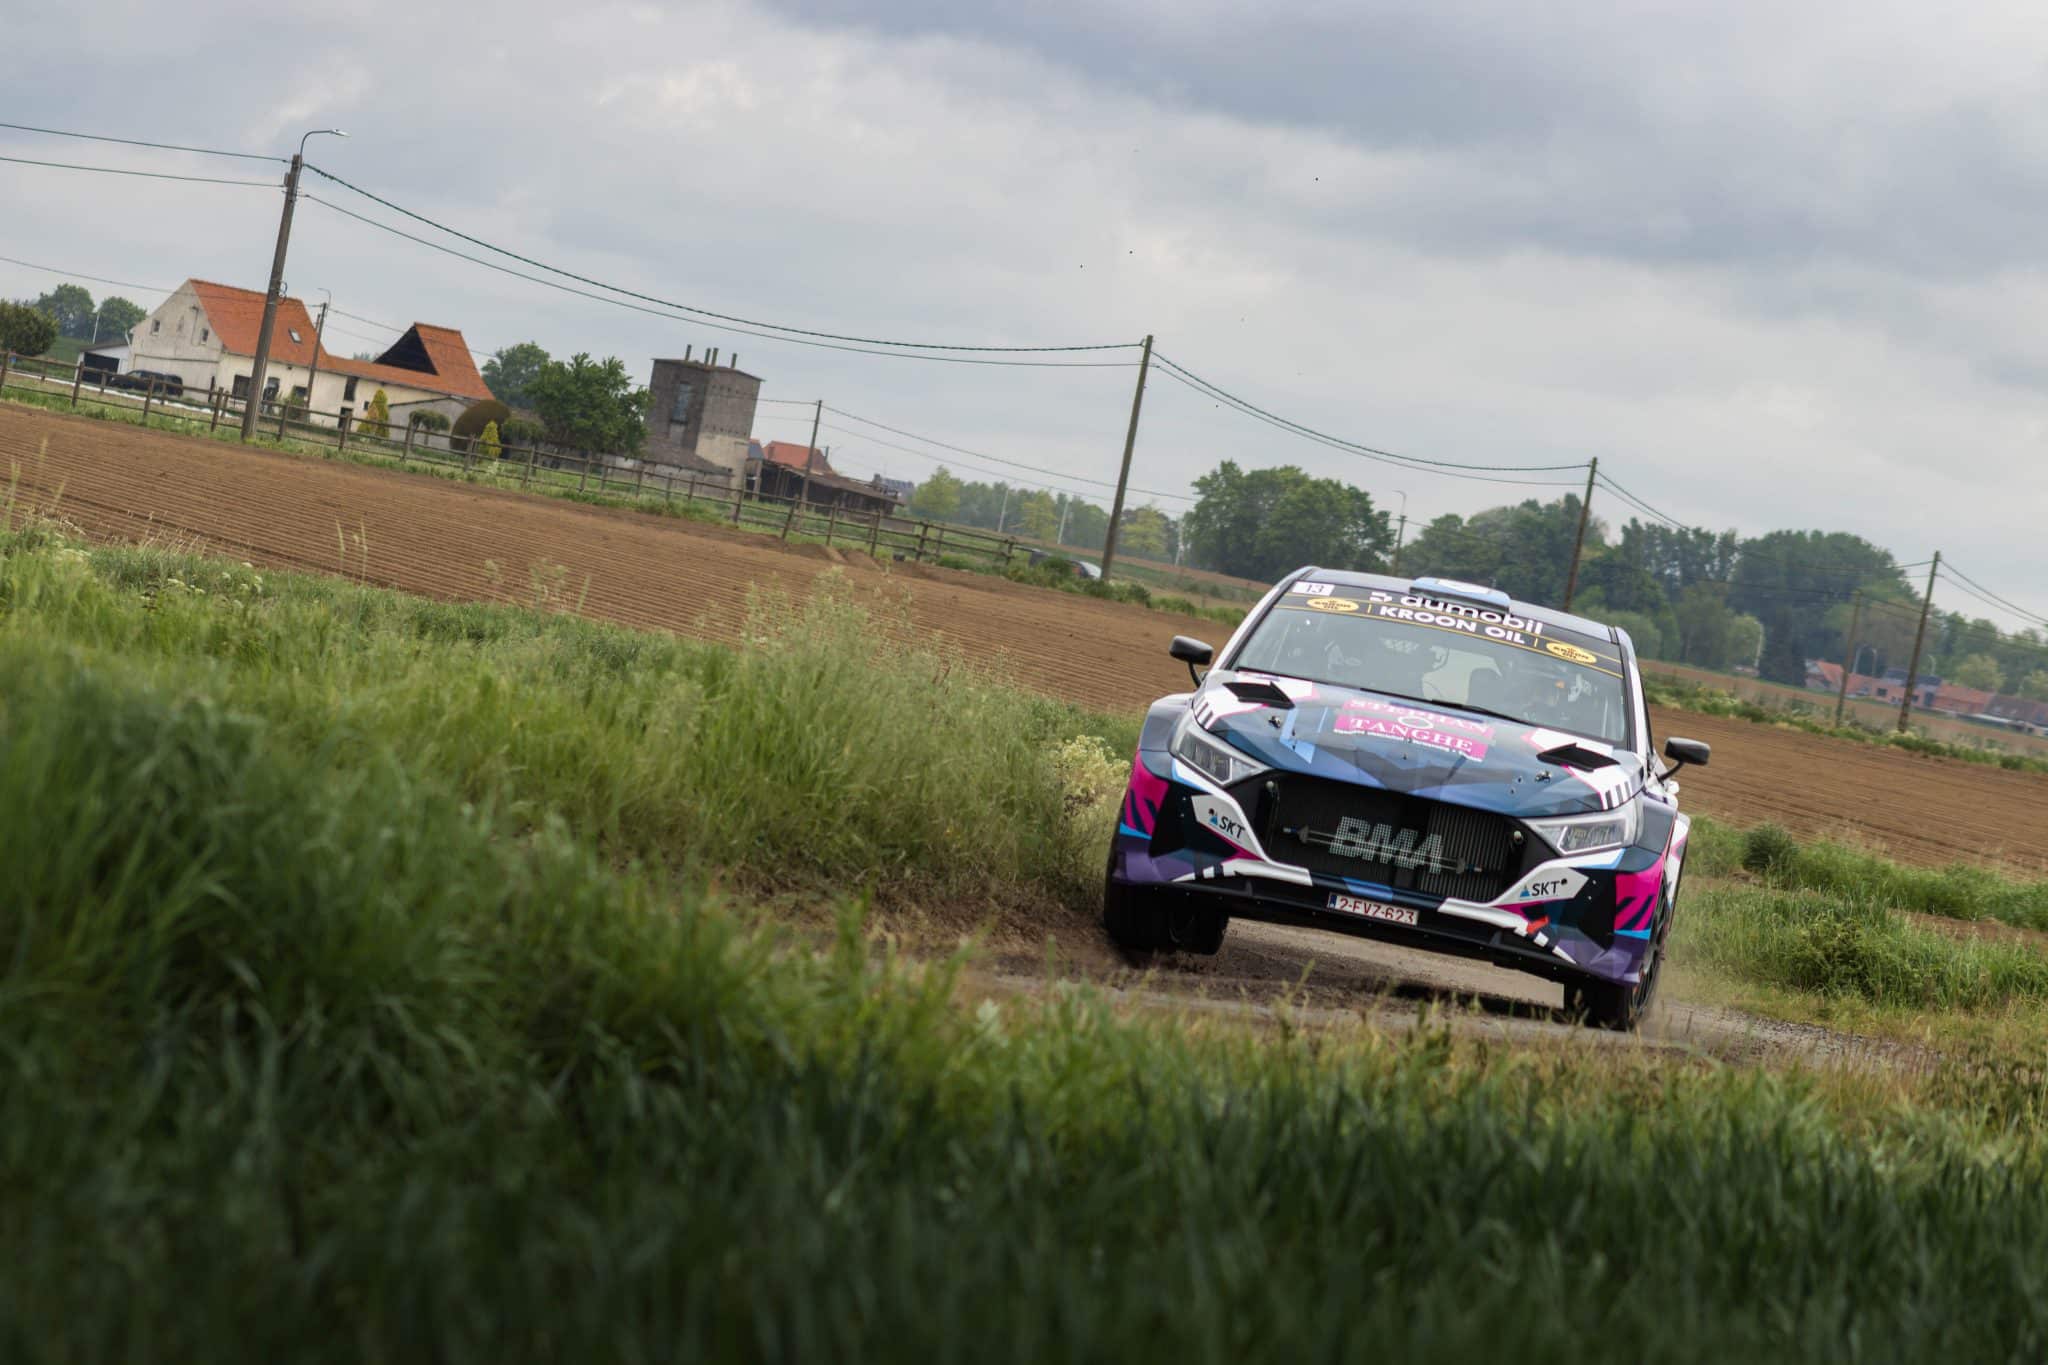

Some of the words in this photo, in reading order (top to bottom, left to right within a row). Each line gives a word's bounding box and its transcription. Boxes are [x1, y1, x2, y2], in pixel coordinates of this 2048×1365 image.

[1379, 605, 1477, 633] KROON
[1485, 626, 1525, 644] OIL
[1400, 595, 1543, 634] dumobil
[1350, 718, 1473, 752] TANGHE
[1219, 816, 1246, 839] SKT
[1328, 816, 1442, 874] BMA
[1531, 880, 1560, 897] SKT
